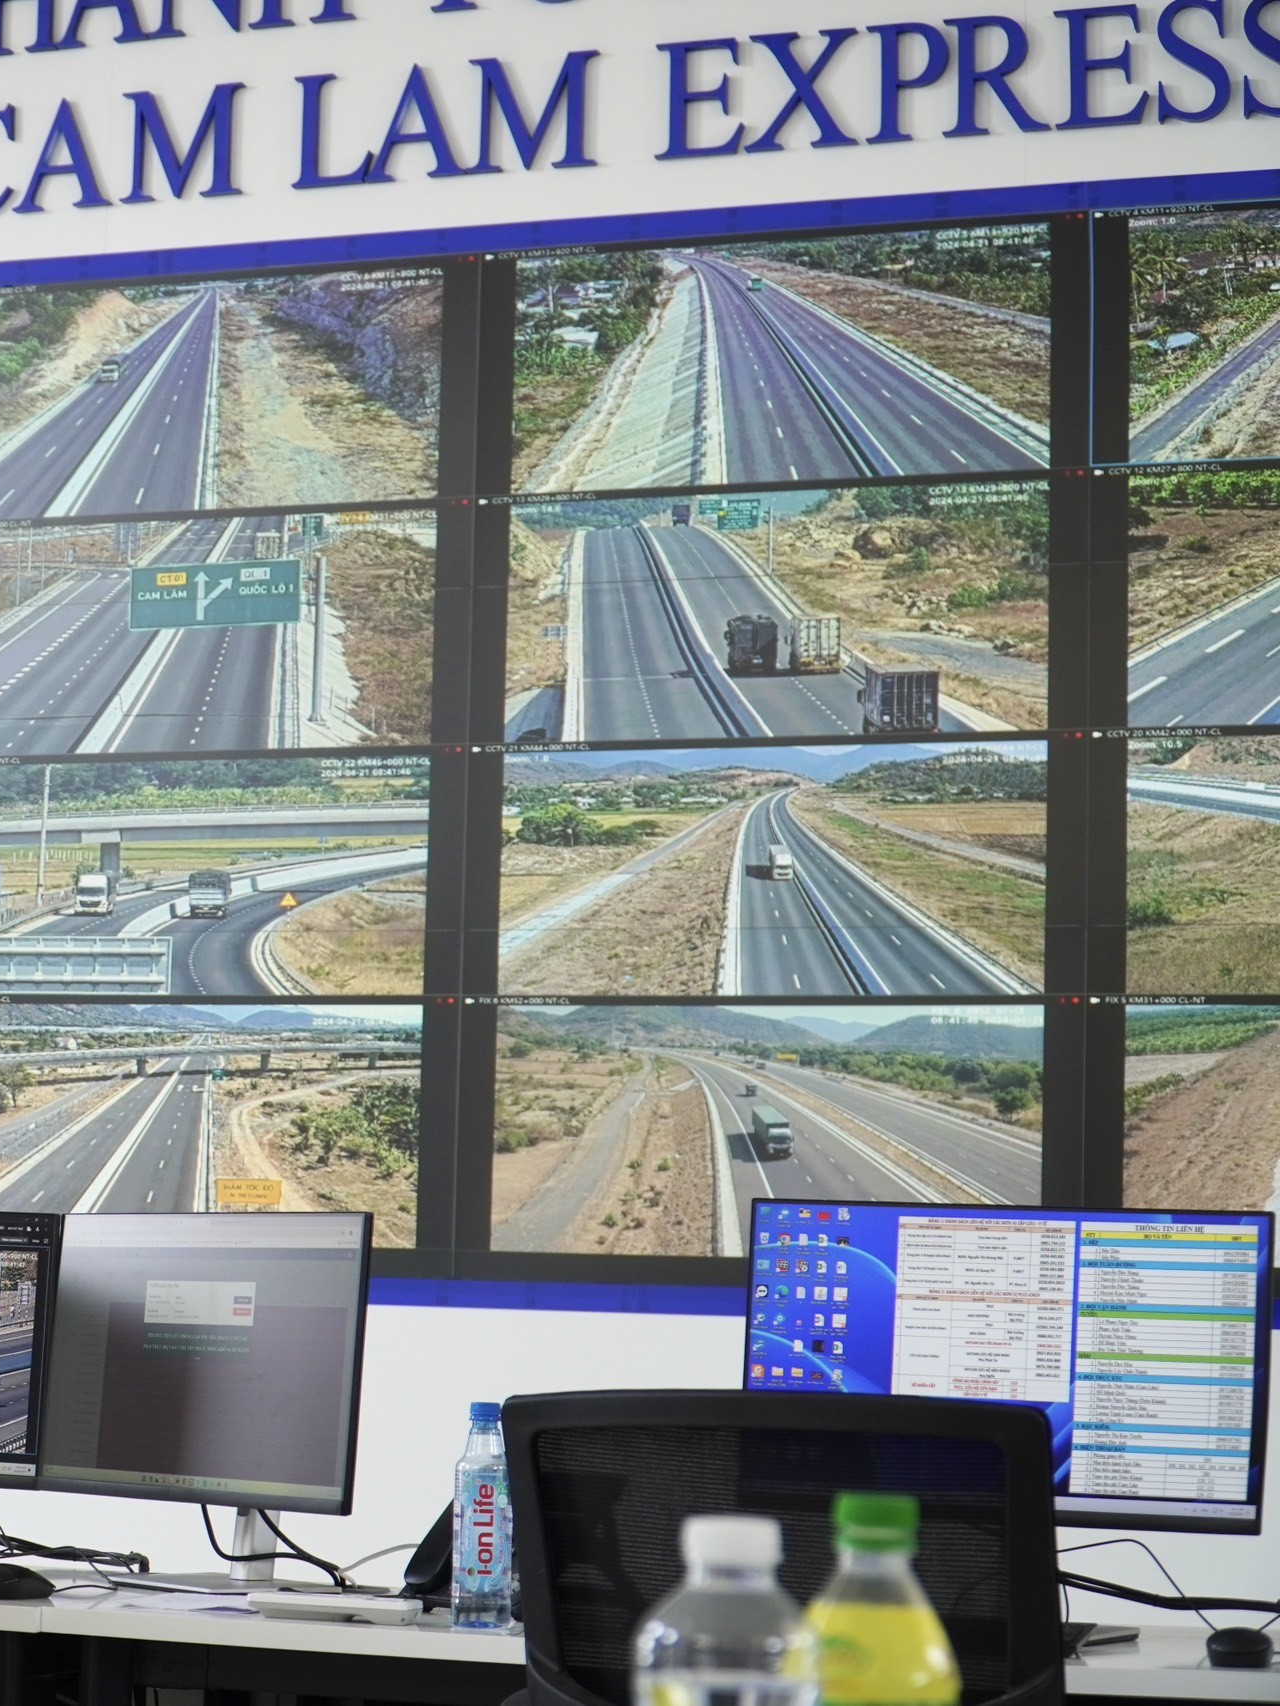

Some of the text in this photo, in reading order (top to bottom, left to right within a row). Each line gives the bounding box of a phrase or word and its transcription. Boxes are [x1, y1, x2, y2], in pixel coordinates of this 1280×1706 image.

[291, 51, 601, 190] LAM
[1108, 209, 1131, 217] CCTV
[1188, 204, 1215, 213] NT-CL
[1128, 216, 1176, 226] Zoom: 1.0
[936, 229, 960, 241] CCTV
[498, 251, 520, 259] CCTV
[572, 246, 596, 255] NT-CL
[340, 272, 362, 282] CCTV
[418, 268, 444, 277] NT-CL
[1108, 467, 1133, 475] CCTV
[1147, 465, 1193, 474] KM27+800
[1195, 464, 1222, 472] NT-CL
[929, 485, 952, 496] CCTV
[1022, 481, 1051, 491] NT-CL
[492, 496, 514, 504] CCTV
[572, 492, 597, 501] NT-CL
[9, 520, 32, 528] CL-NT
[137, 588, 187, 600] CAM LÂM
[239, 583, 294, 595] QUỐC LỘ 1
[1107, 728, 1222, 737] CCTV 20 KM42+000 NT-CL
[1128, 740, 1157, 749] Zoom:
[320, 759, 344, 768] CCTV
[345, 759, 356, 767] 22
[405, 757, 431, 766] NT-CL
[320, 768, 370, 778] 2024-04-21
[1105, 996, 1119, 1004] FIX
[1129, 996, 1177, 1004] KM31+000
[1178, 996, 1206, 1004] CL-NT
[22, 1253, 39, 1261] NT-CL
[466, 1483, 495, 1577] i-on Life
